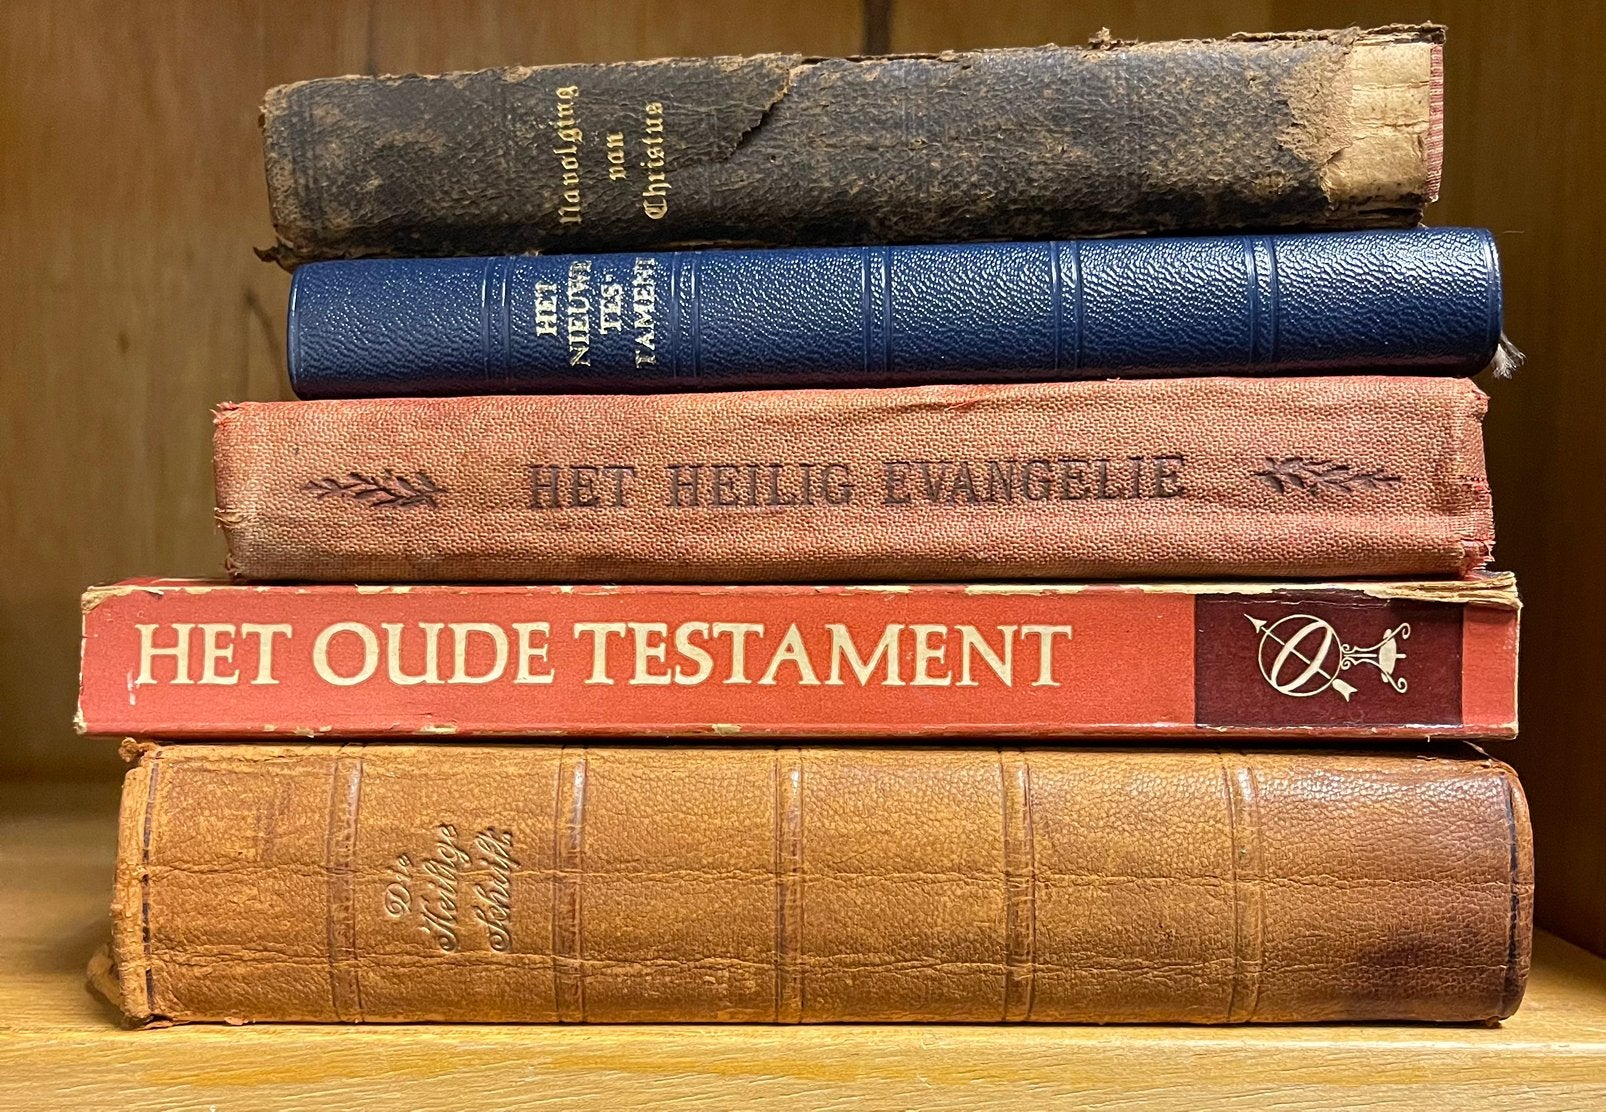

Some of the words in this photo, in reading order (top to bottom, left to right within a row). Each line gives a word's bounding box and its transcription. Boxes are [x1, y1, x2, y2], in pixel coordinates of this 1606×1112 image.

[606, 131, 627, 181] van
[640, 101, 672, 220] Christus
[535, 281, 558, 337] HET
[567, 260, 592, 367] NIEUWE
[633, 257, 657, 370] TAMENT
[527, 465, 637, 509] HET
[664, 463, 855, 508] HEILIG
[882, 453, 1187, 505] EVANGELIE
[134, 622, 293, 686] HET
[312, 621, 556, 687] OUDE
[573, 621, 1073, 688] TESTAMENT
[384, 853, 413, 918] Die
[471, 826, 521, 953] Schrift
